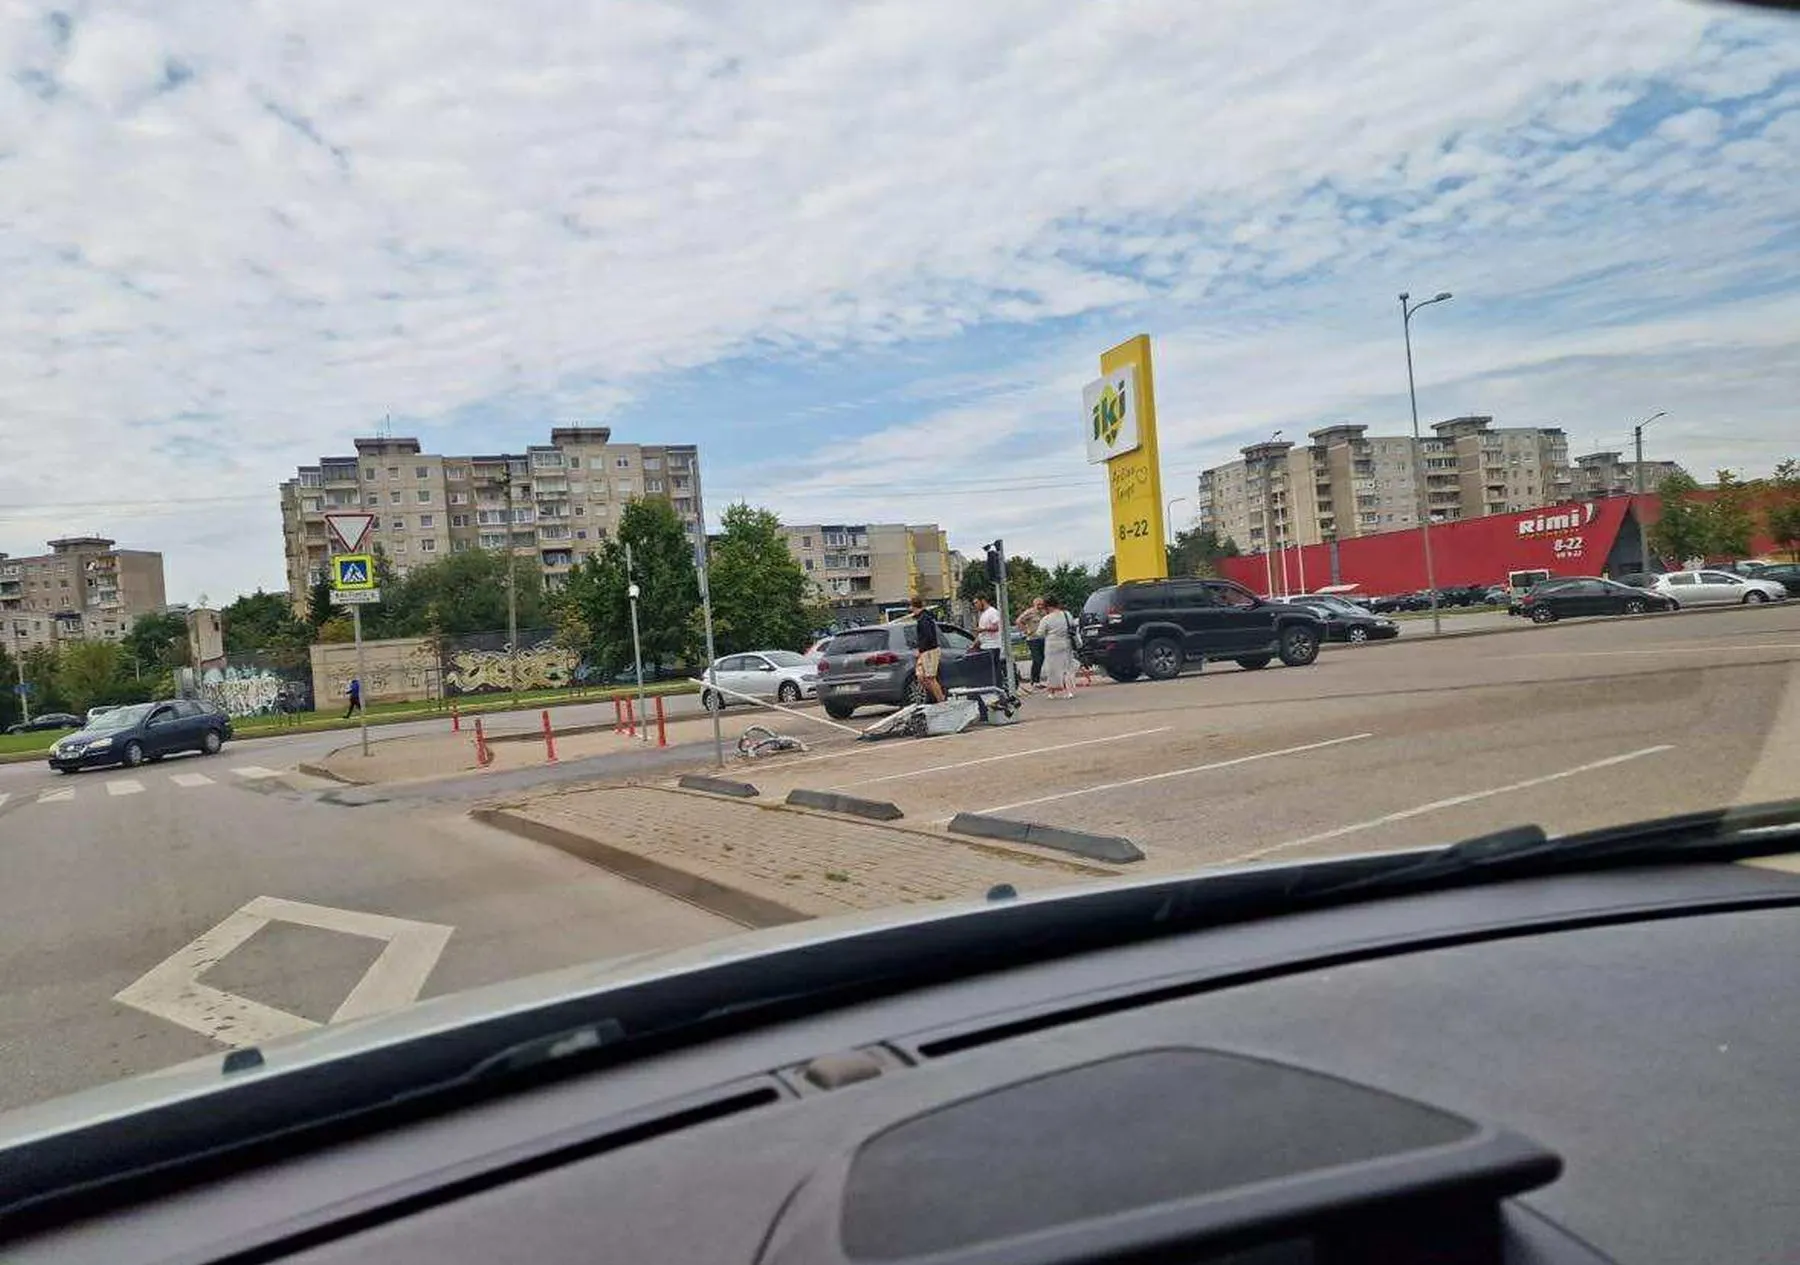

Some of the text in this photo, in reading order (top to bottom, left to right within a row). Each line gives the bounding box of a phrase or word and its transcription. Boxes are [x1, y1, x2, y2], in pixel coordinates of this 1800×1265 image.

[1093, 380, 1126, 441] iki
[1119, 519, 1149, 540] 8-22
[1519, 509, 1579, 535] Rimi
[1554, 536, 1583, 552] 8-22
